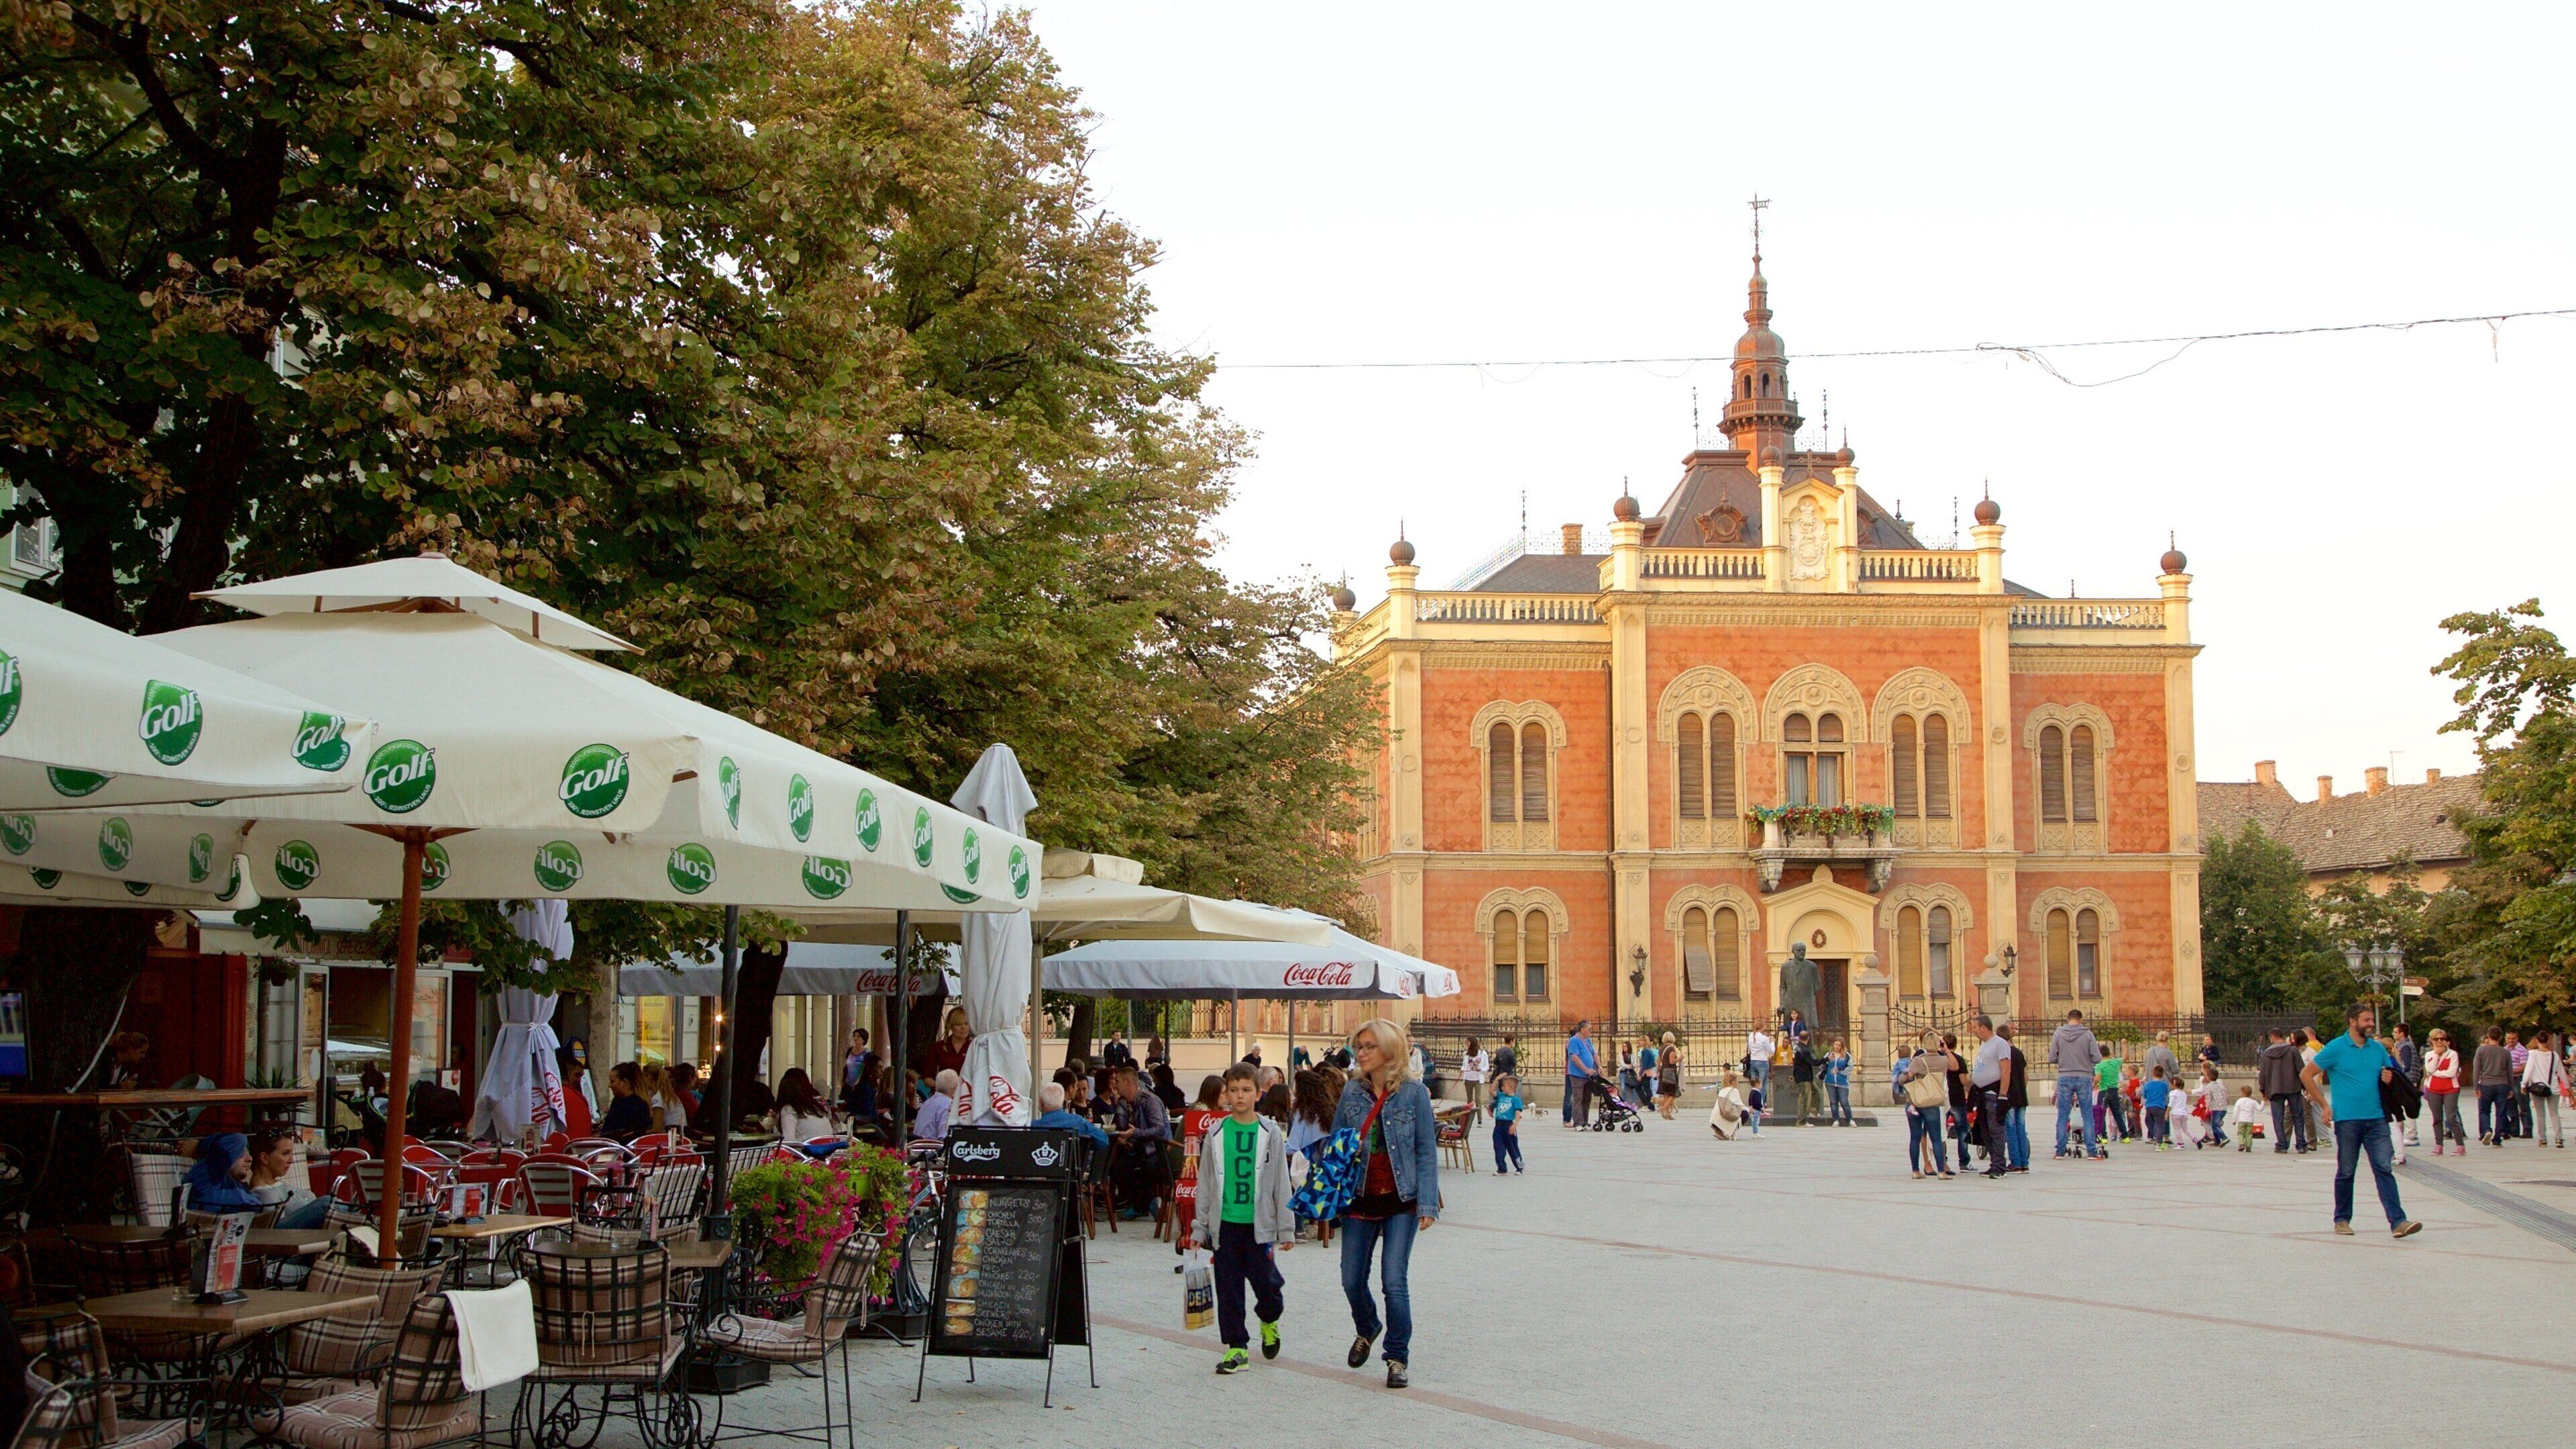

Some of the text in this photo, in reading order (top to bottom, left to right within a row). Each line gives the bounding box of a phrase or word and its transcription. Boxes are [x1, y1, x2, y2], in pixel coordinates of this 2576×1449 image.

[139, 690, 197, 739] Golf
[363, 747, 435, 794] Golf
[558, 752, 629, 800] Golf
[388, 799, 420, 810] JEDINSTVEN
[420, 784, 431, 800] UKUS
[580, 803, 612, 815] JEDINSTVEN
[612, 789, 624, 804] UKUS
[788, 784, 811, 824] Golf
[855, 797, 877, 835] Golf
[913, 816, 932, 850] Golf
[963, 837, 980, 868] Golf
[1009, 853, 1028, 884] Golf
[857, 971, 920, 992] Coca-Cla
[1284, 962, 1355, 985] Coca-Cola
[953, 1141, 1001, 1162] Carlsberg
[989, 1197, 1030, 1208] NUGGETS
[975, 1328, 1007, 1337] SESAME
